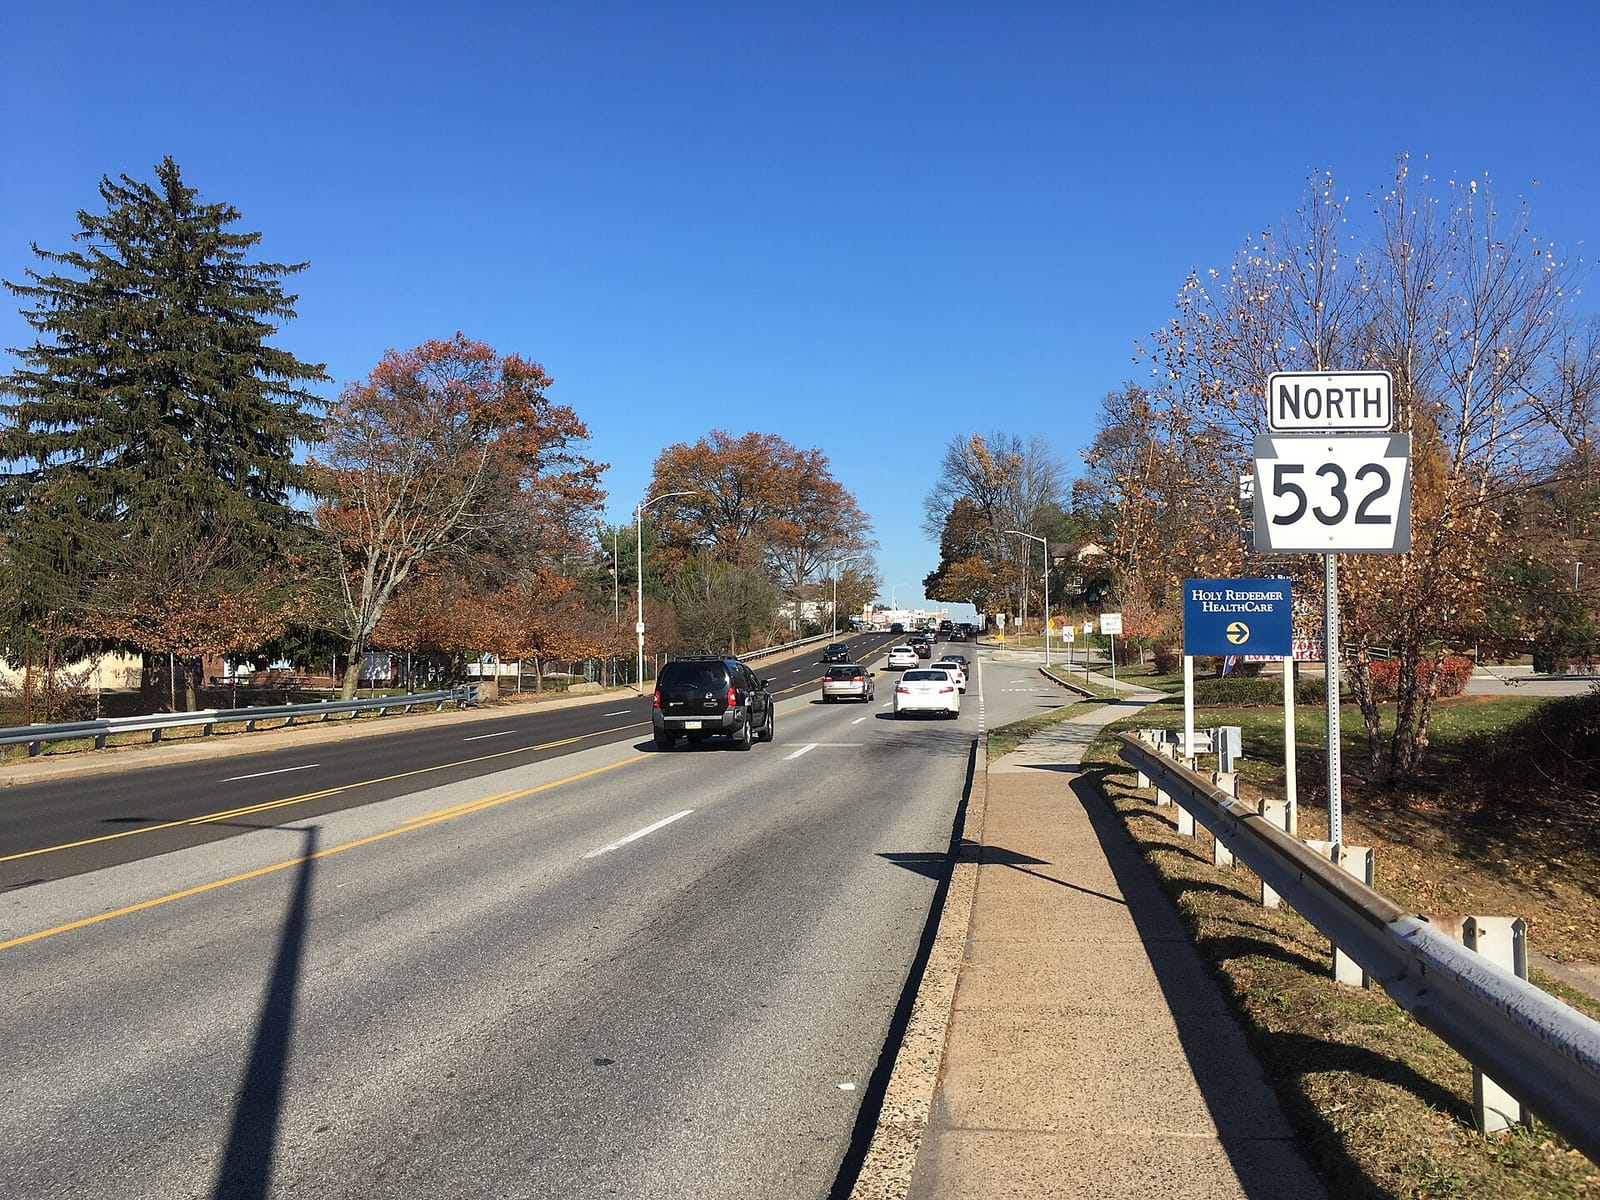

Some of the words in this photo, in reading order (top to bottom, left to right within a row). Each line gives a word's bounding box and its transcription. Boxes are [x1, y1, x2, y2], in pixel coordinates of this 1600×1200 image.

[1279, 384, 1381, 420] NORTH
[1272, 463, 1392, 526] 532
[1191, 589, 1222, 601] HOLY
[1225, 589, 1283, 601] REDEEMER
[1202, 601, 1274, 613] HEALTHCARE
